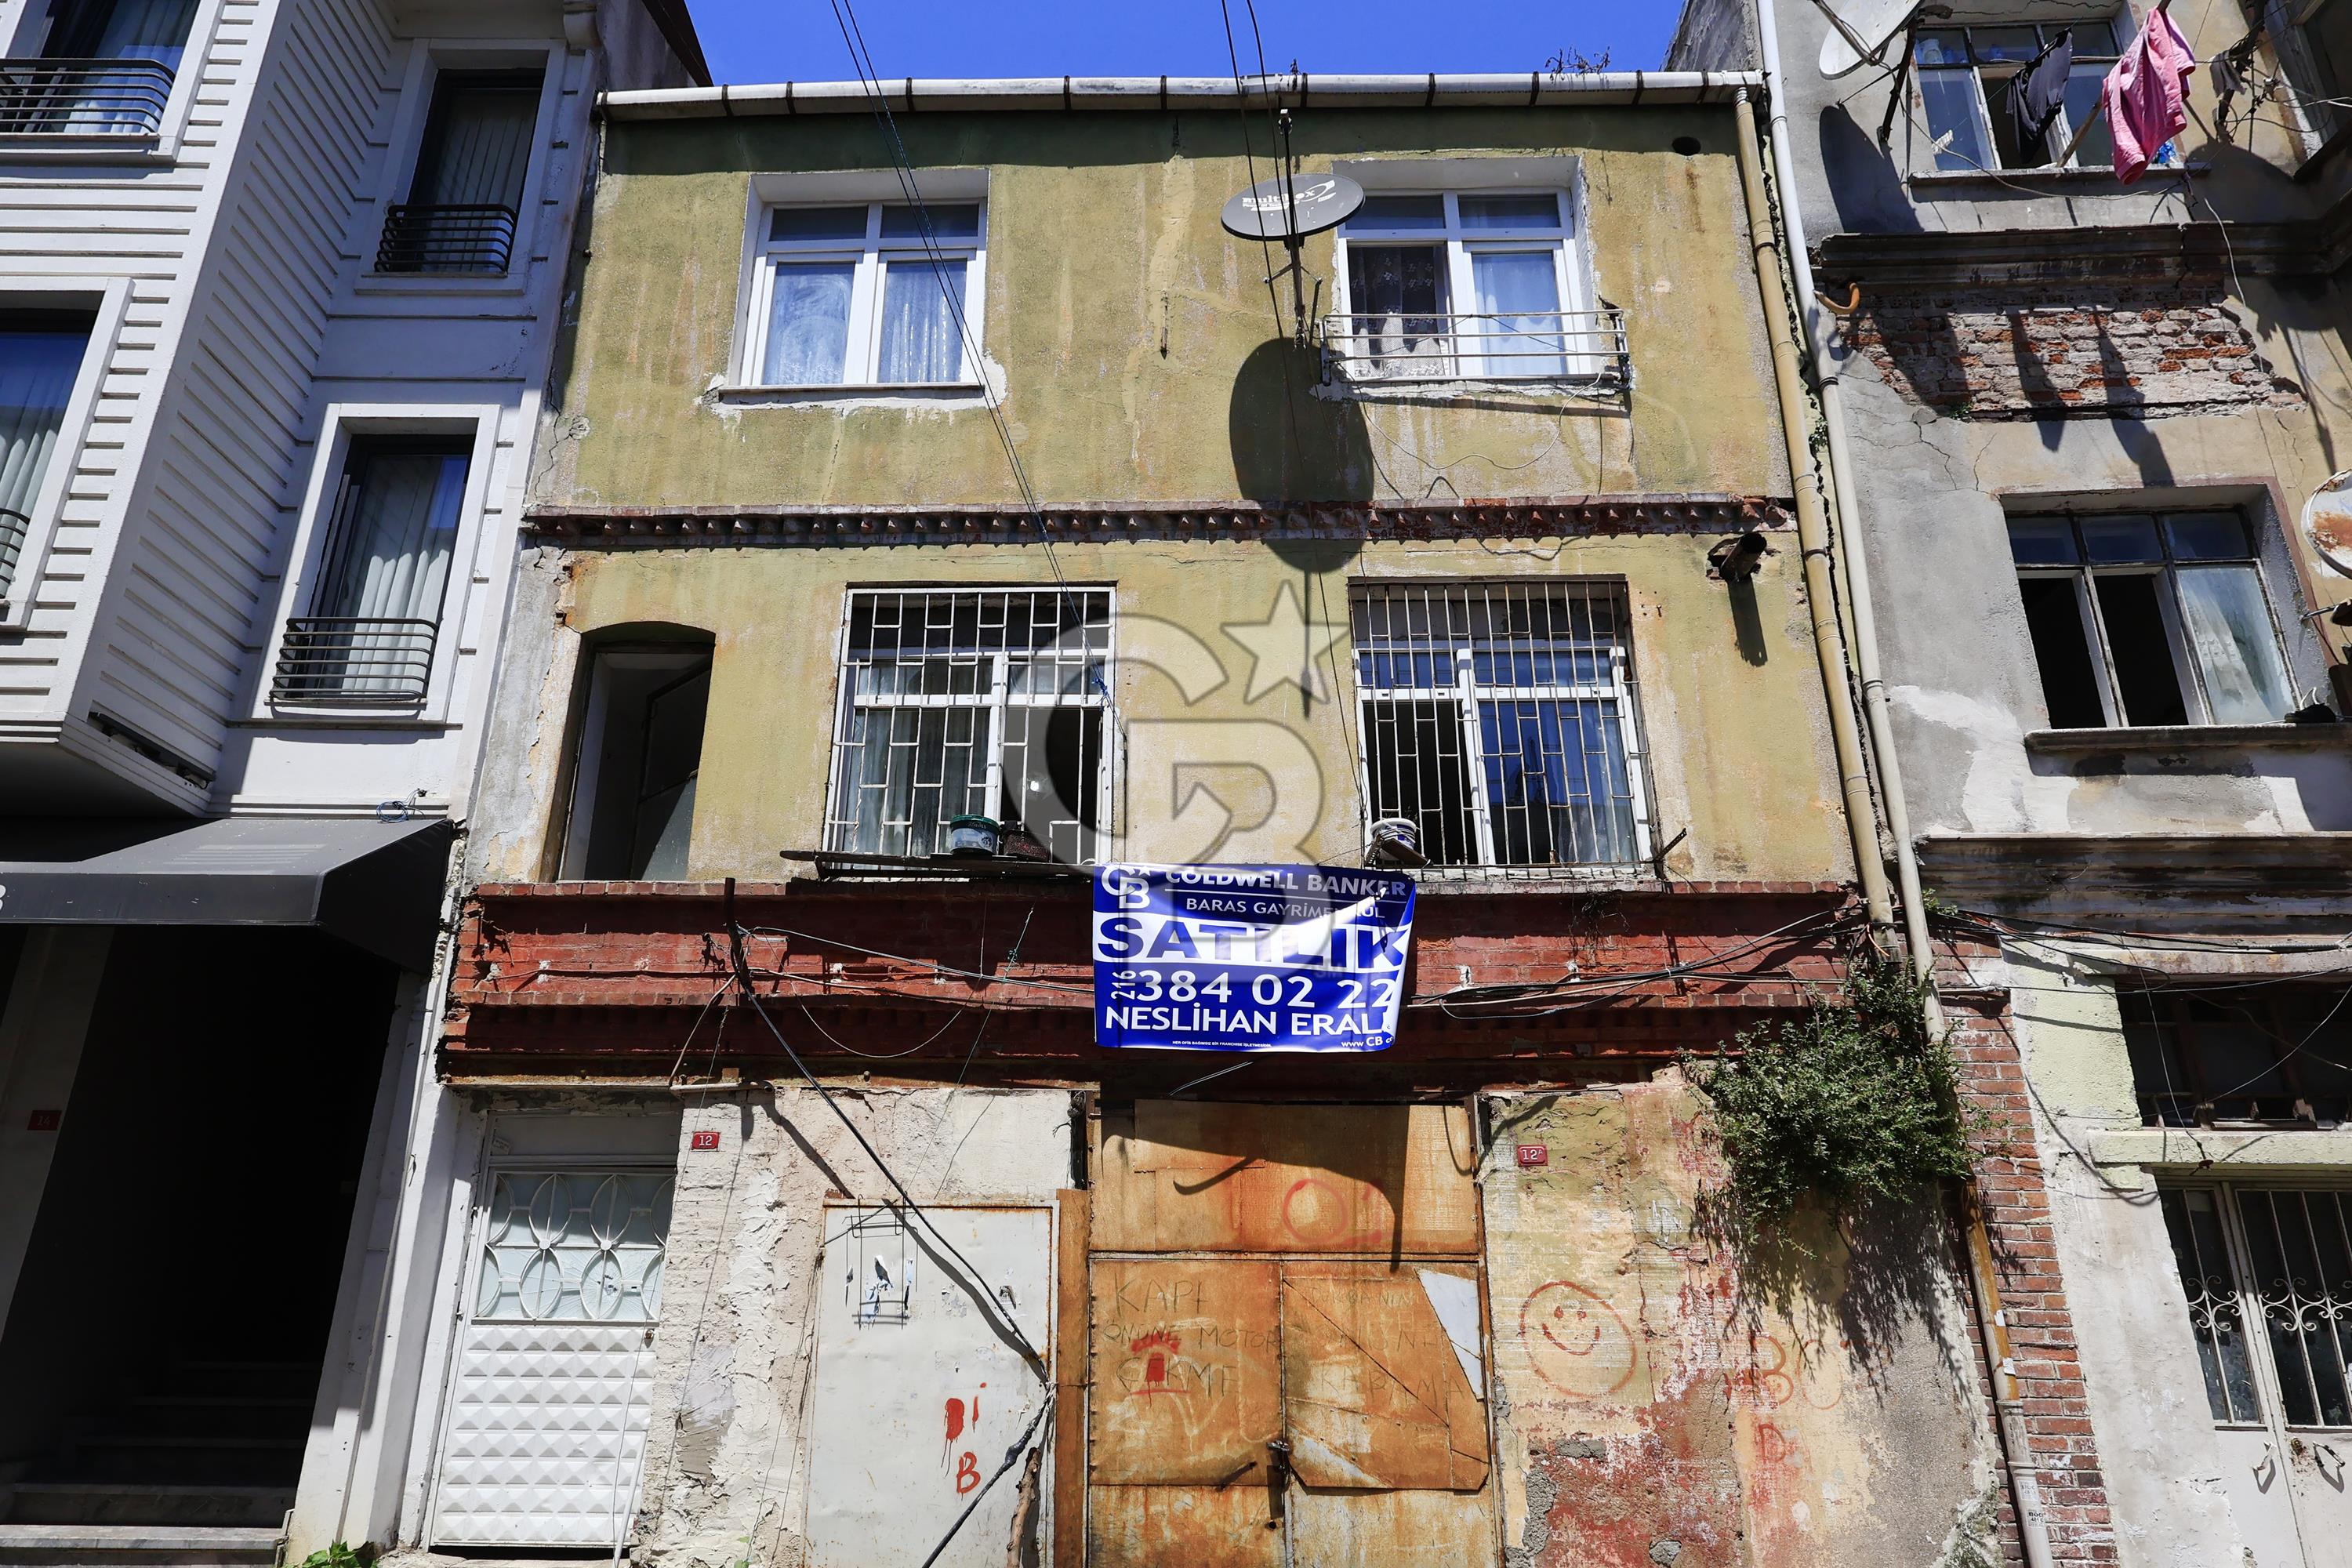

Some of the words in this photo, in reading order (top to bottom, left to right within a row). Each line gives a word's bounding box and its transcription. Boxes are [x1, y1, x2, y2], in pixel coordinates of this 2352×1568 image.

[1165, 869, 1299, 890] COLDWELL
[1307, 874, 1406, 896] BANKER
[1186, 898, 1247, 913] BARAS
[1253, 902, 1385, 919] GAYRİMEUL
[1098, 916, 1412, 969] SATILIK
[1111, 970, 1136, 1000] 216
[1137, 970, 1232, 1003] 384
[1252, 974, 1315, 1007] 02
[1337, 978, 1396, 1009] 22
[1105, 1002, 1276, 1035] NESLİHAN
[1290, 1012, 1386, 1036] ERAL
[699, 1134, 713, 1146] 12
[956, 1450, 982, 1494] B
